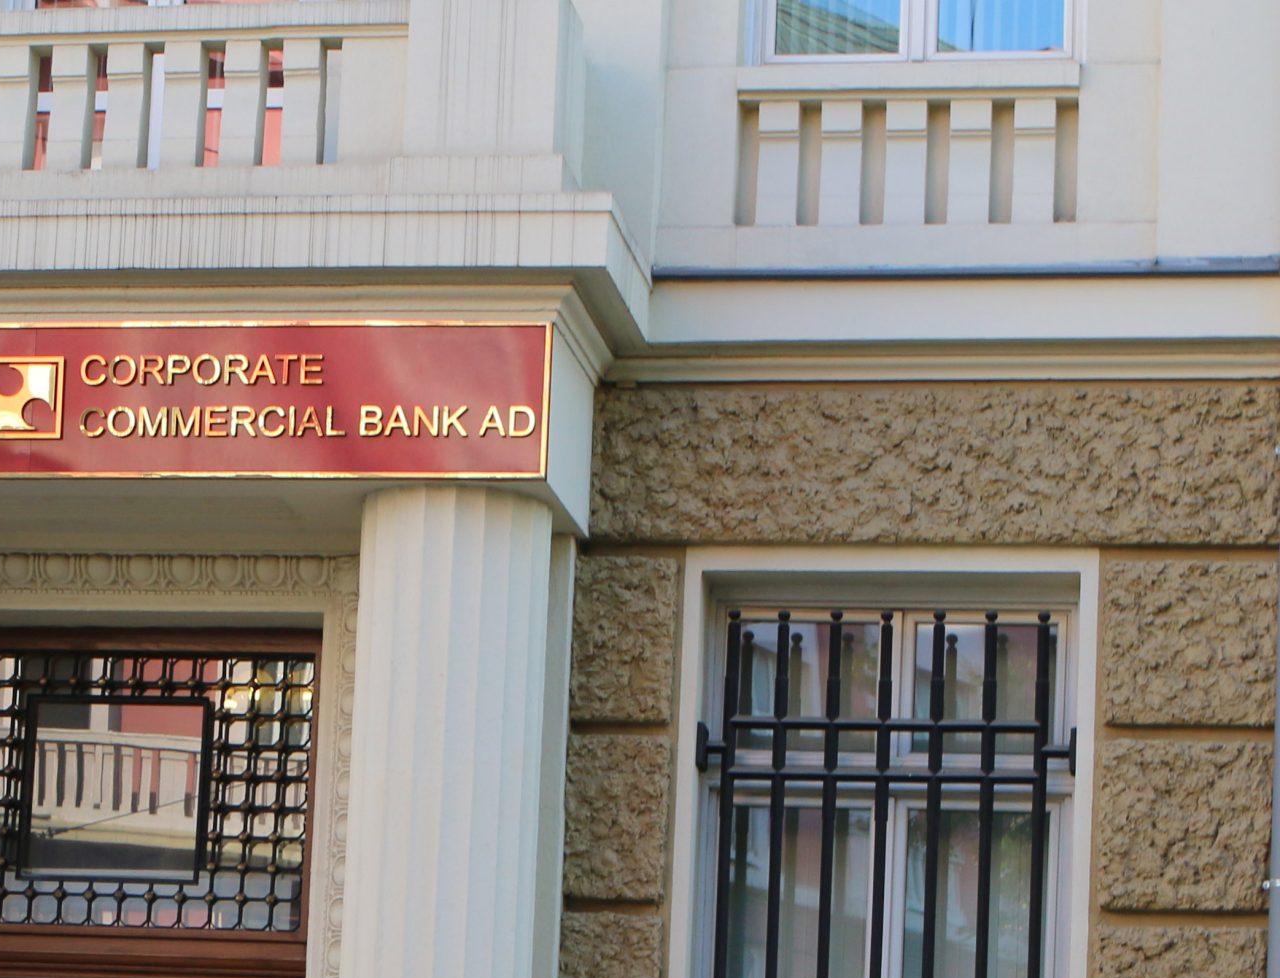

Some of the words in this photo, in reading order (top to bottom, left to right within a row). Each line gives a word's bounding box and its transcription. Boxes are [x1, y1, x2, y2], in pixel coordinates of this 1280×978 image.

[80, 353, 323, 386] CORPORATE
[79, 405, 346, 438] COMMERCIAL
[358, 404, 469, 438] BANK
[478, 404, 536, 438] AD
